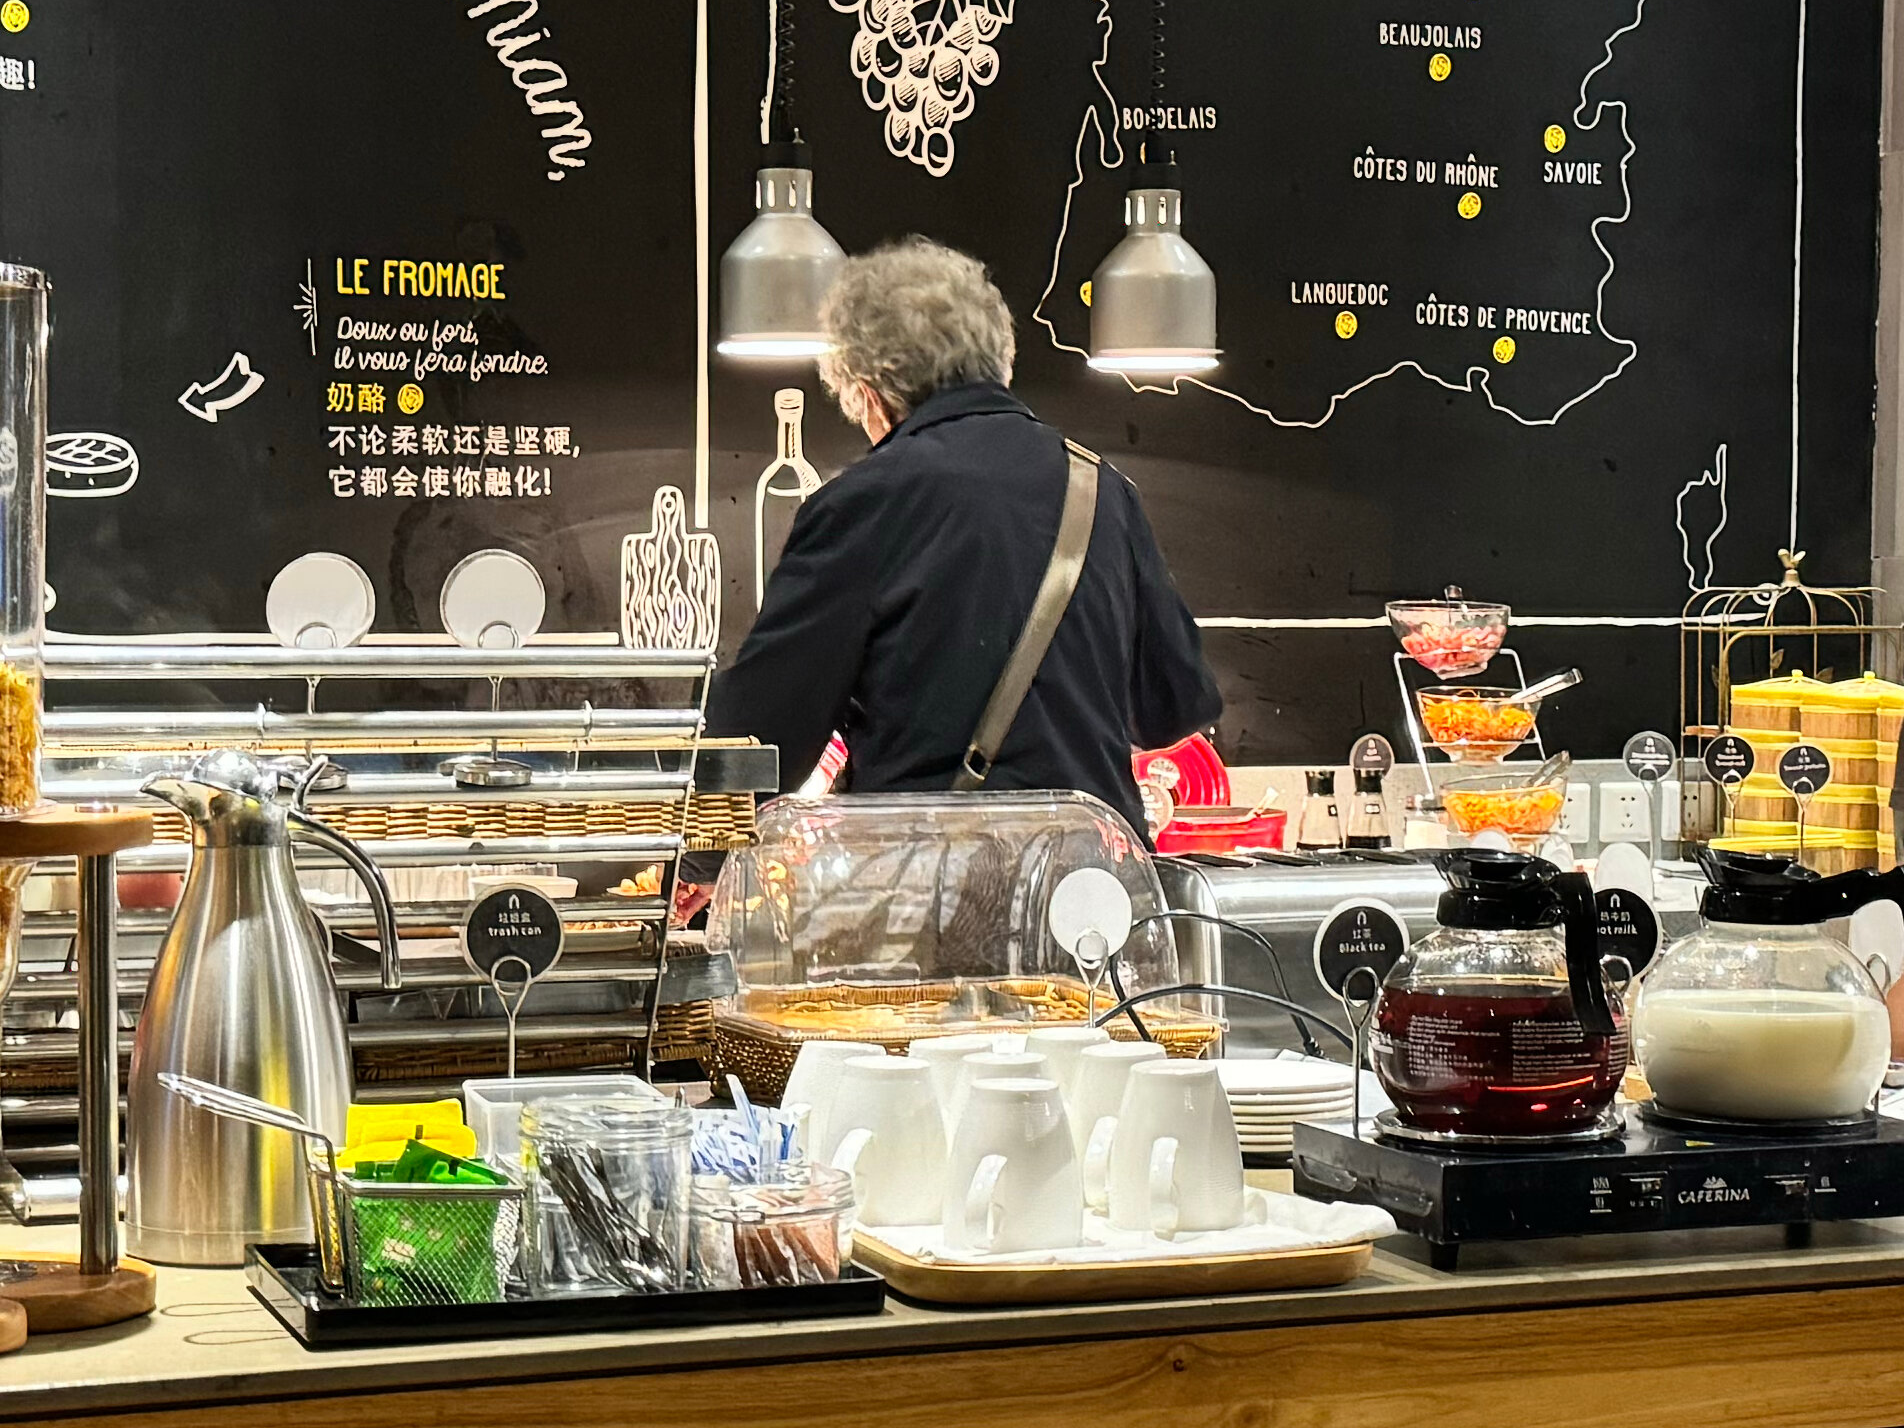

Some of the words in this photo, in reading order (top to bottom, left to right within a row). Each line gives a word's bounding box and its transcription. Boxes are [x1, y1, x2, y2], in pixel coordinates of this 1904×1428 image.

[1379, 23, 1482, 49] BEAUJOLAIS
[1353, 147, 1408, 182] CÔTES
[1416, 161, 1438, 185] DU
[1445, 153, 1499, 189] RHÔNE
[1543, 162, 1602, 186] SAVOIE
[336, 257, 370, 296] LE
[383, 260, 507, 300] FROMAGE
[1291, 283, 1389, 307] LANGUEDOC
[1415, 294, 1469, 330] CÔTES
[1476, 307, 1498, 331] DE
[1505, 308, 1592, 334] PROVENCE
[337, 316, 396, 341] Doux
[400, 322, 428, 342] ou
[334, 346, 354, 369] il
[358, 351, 410, 370] vous
[414, 348, 467, 381] fera
[469, 350, 549, 382] fondre.
[326, 382, 386, 415] 奶酪
[1614, 923, 1638, 935] milk
[1339, 941, 1366, 953] Black
